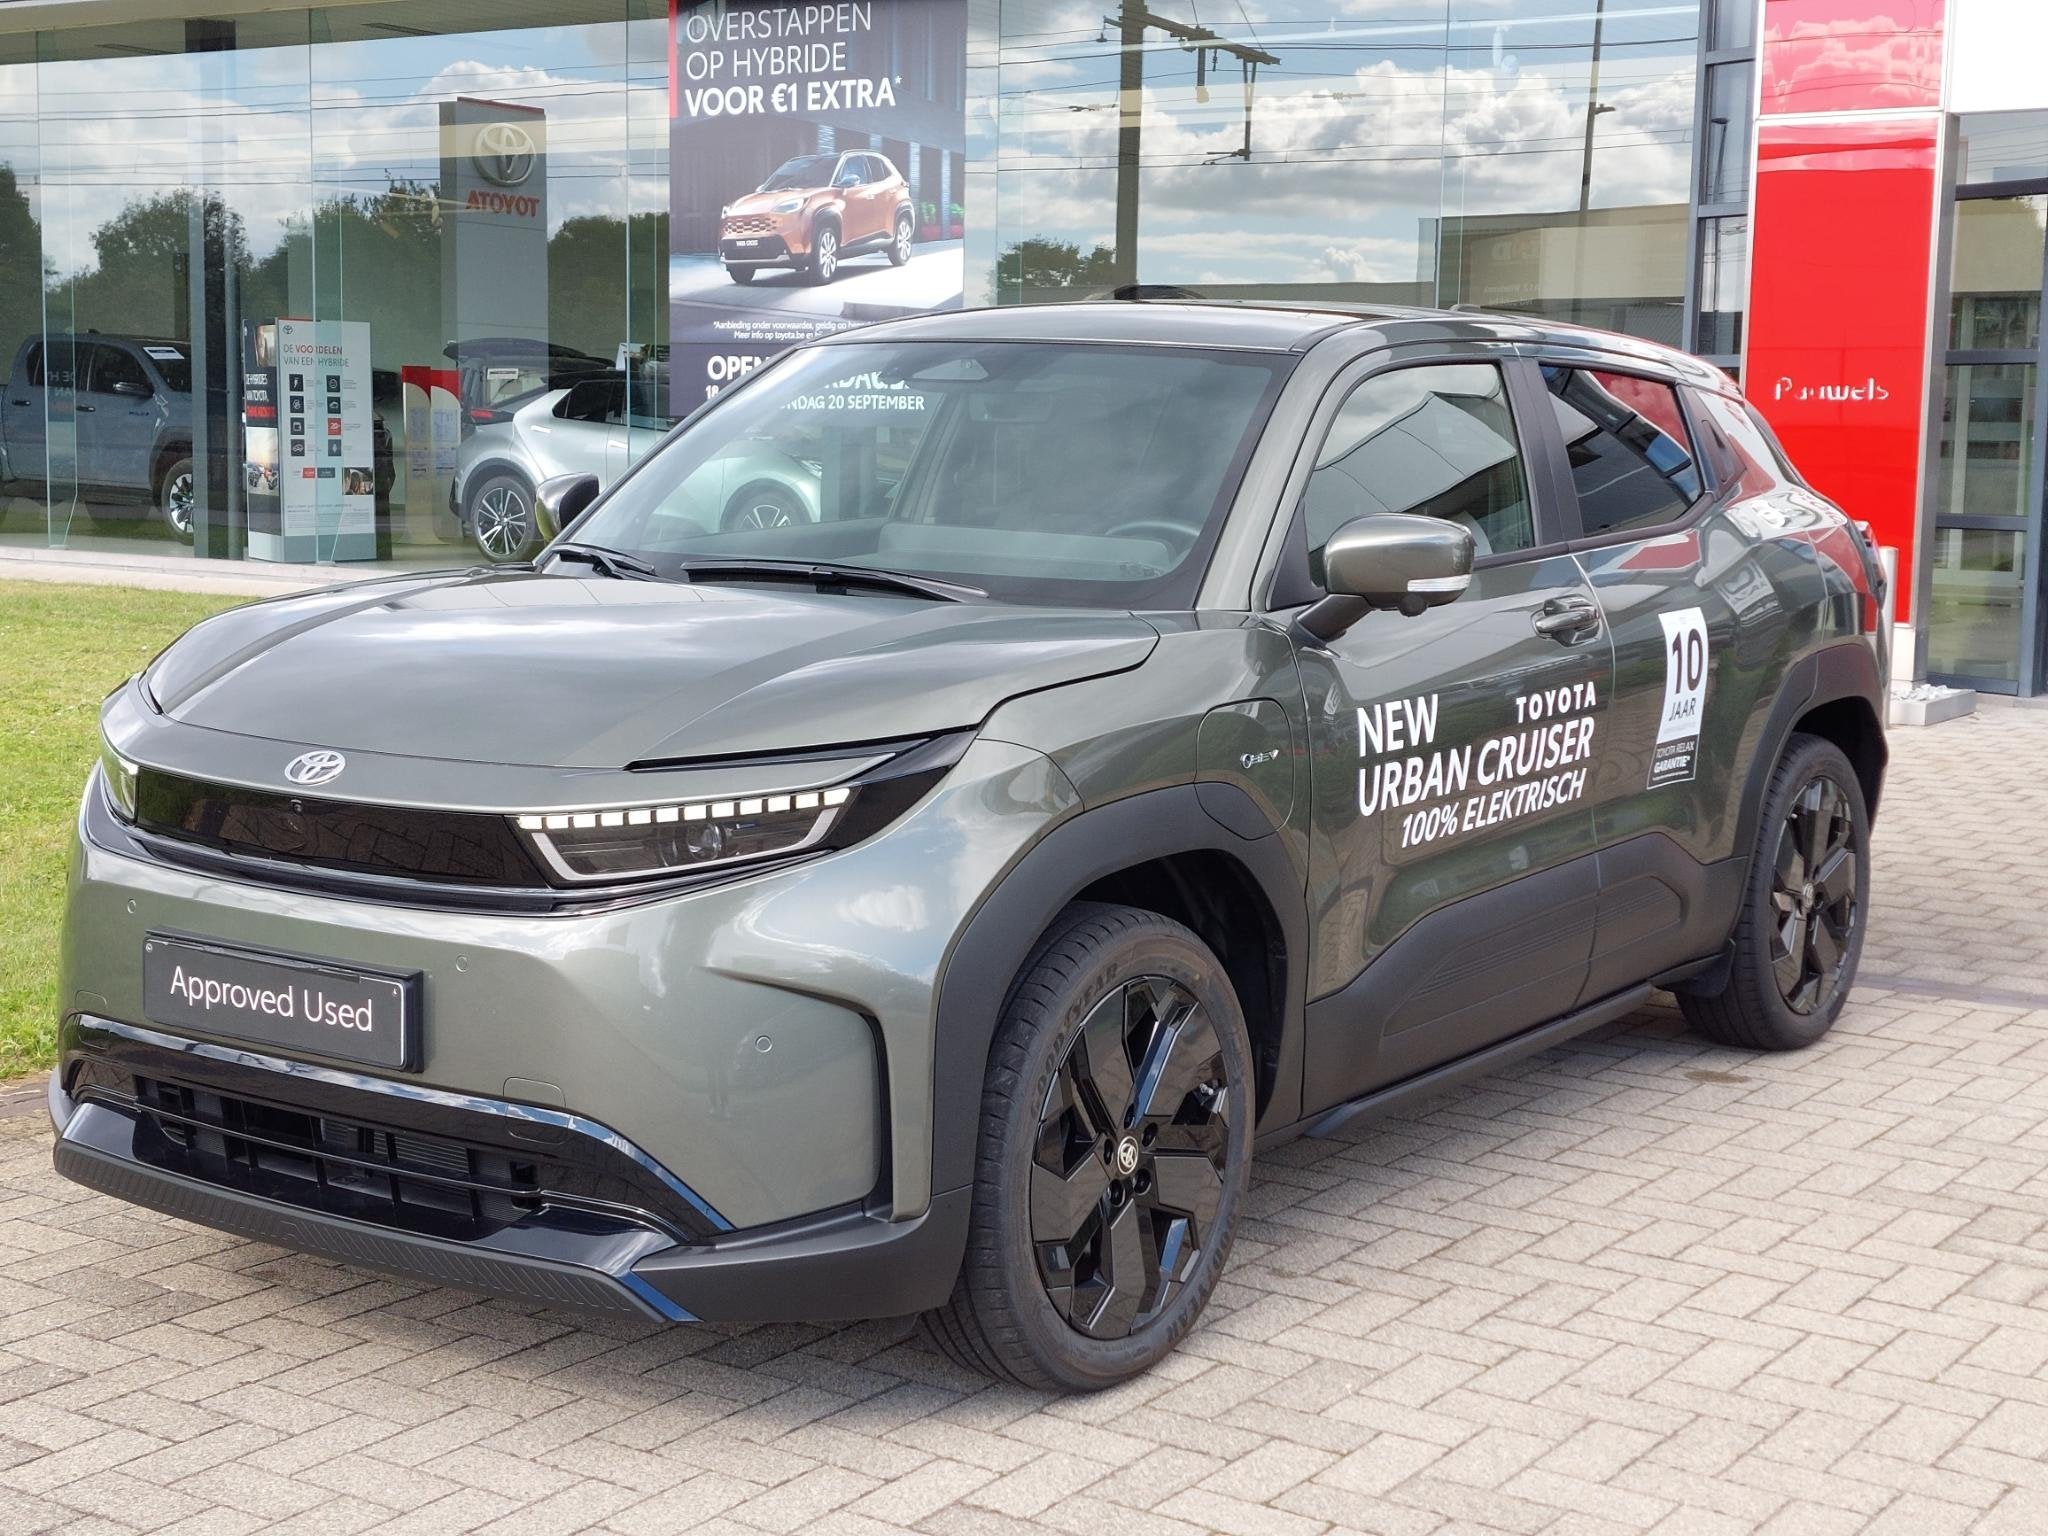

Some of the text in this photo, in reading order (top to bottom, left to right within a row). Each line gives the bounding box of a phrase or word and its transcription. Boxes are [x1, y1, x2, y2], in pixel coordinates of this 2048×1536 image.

[686, 2, 871, 43] OVERSTAPPEN
[686, 42, 846, 80] OP HYBRIDE
[685, 85, 764, 116] VOOR
[771, 82, 797, 112] €1
[284, 344, 293, 353] DE
[765, 332, 774, 340] op
[284, 356, 300, 365] VAN
[828, 395, 845, 409] 20
[847, 395, 925, 410] SEPTEMBER
[1672, 628, 1703, 695] 10
[1516, 681, 1597, 723] TOYOTA
[1669, 697, 1697, 722] JAAR
[1357, 693, 1438, 757] NEW
[1358, 716, 1595, 816] URBAN CRUISER
[1401, 767, 1587, 848] 100% ELEKTRISCH
[170, 966, 372, 1032] Approved Used
